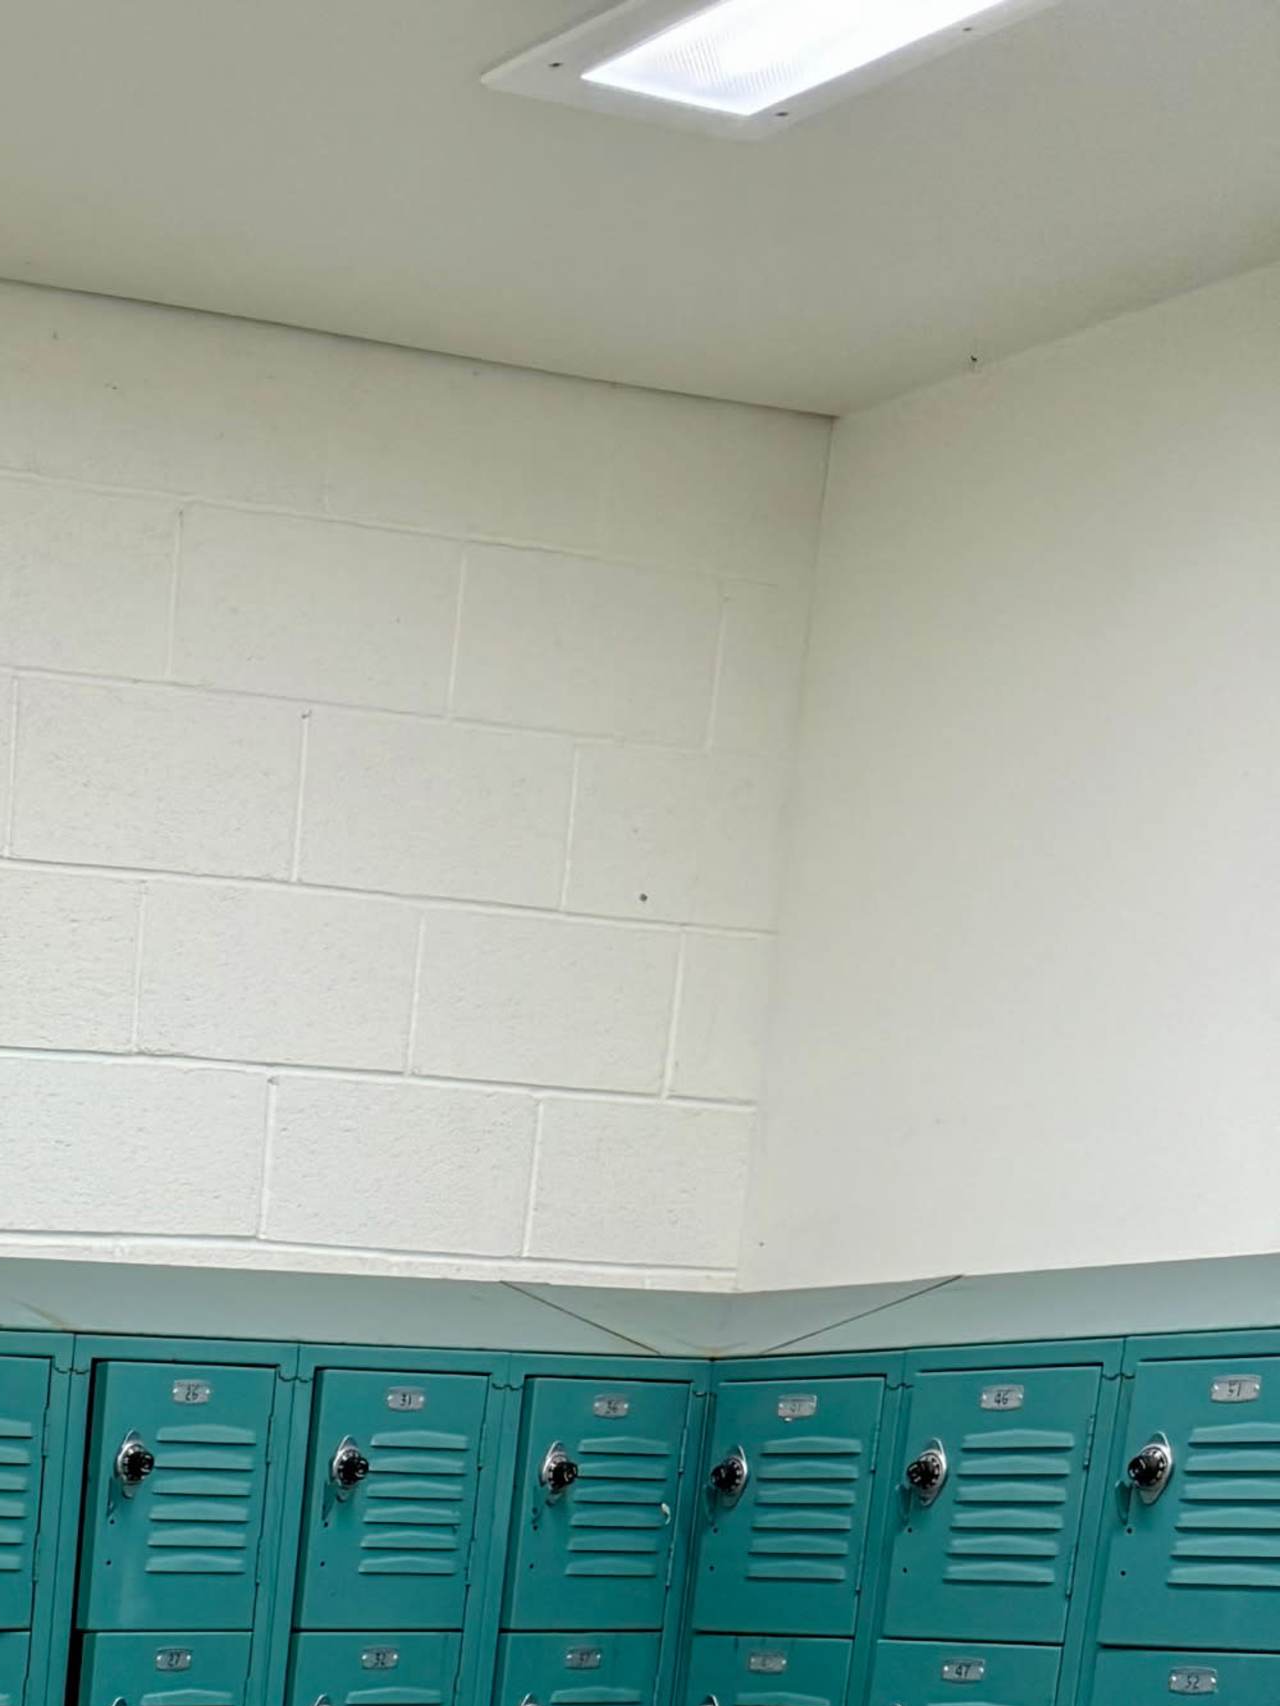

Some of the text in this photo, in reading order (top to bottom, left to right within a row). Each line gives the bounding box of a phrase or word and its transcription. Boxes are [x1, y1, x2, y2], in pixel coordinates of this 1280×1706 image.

[185, 1384, 199, 1401] 26
[1227, 1380, 1241, 1397] 51
[400, 1392, 412, 1407] 31
[993, 1390, 1009, 1405] 46
[167, 1653, 180, 1667] 27
[955, 1663, 971, 1677] 47
[1185, 1674, 1199, 1689] 52
